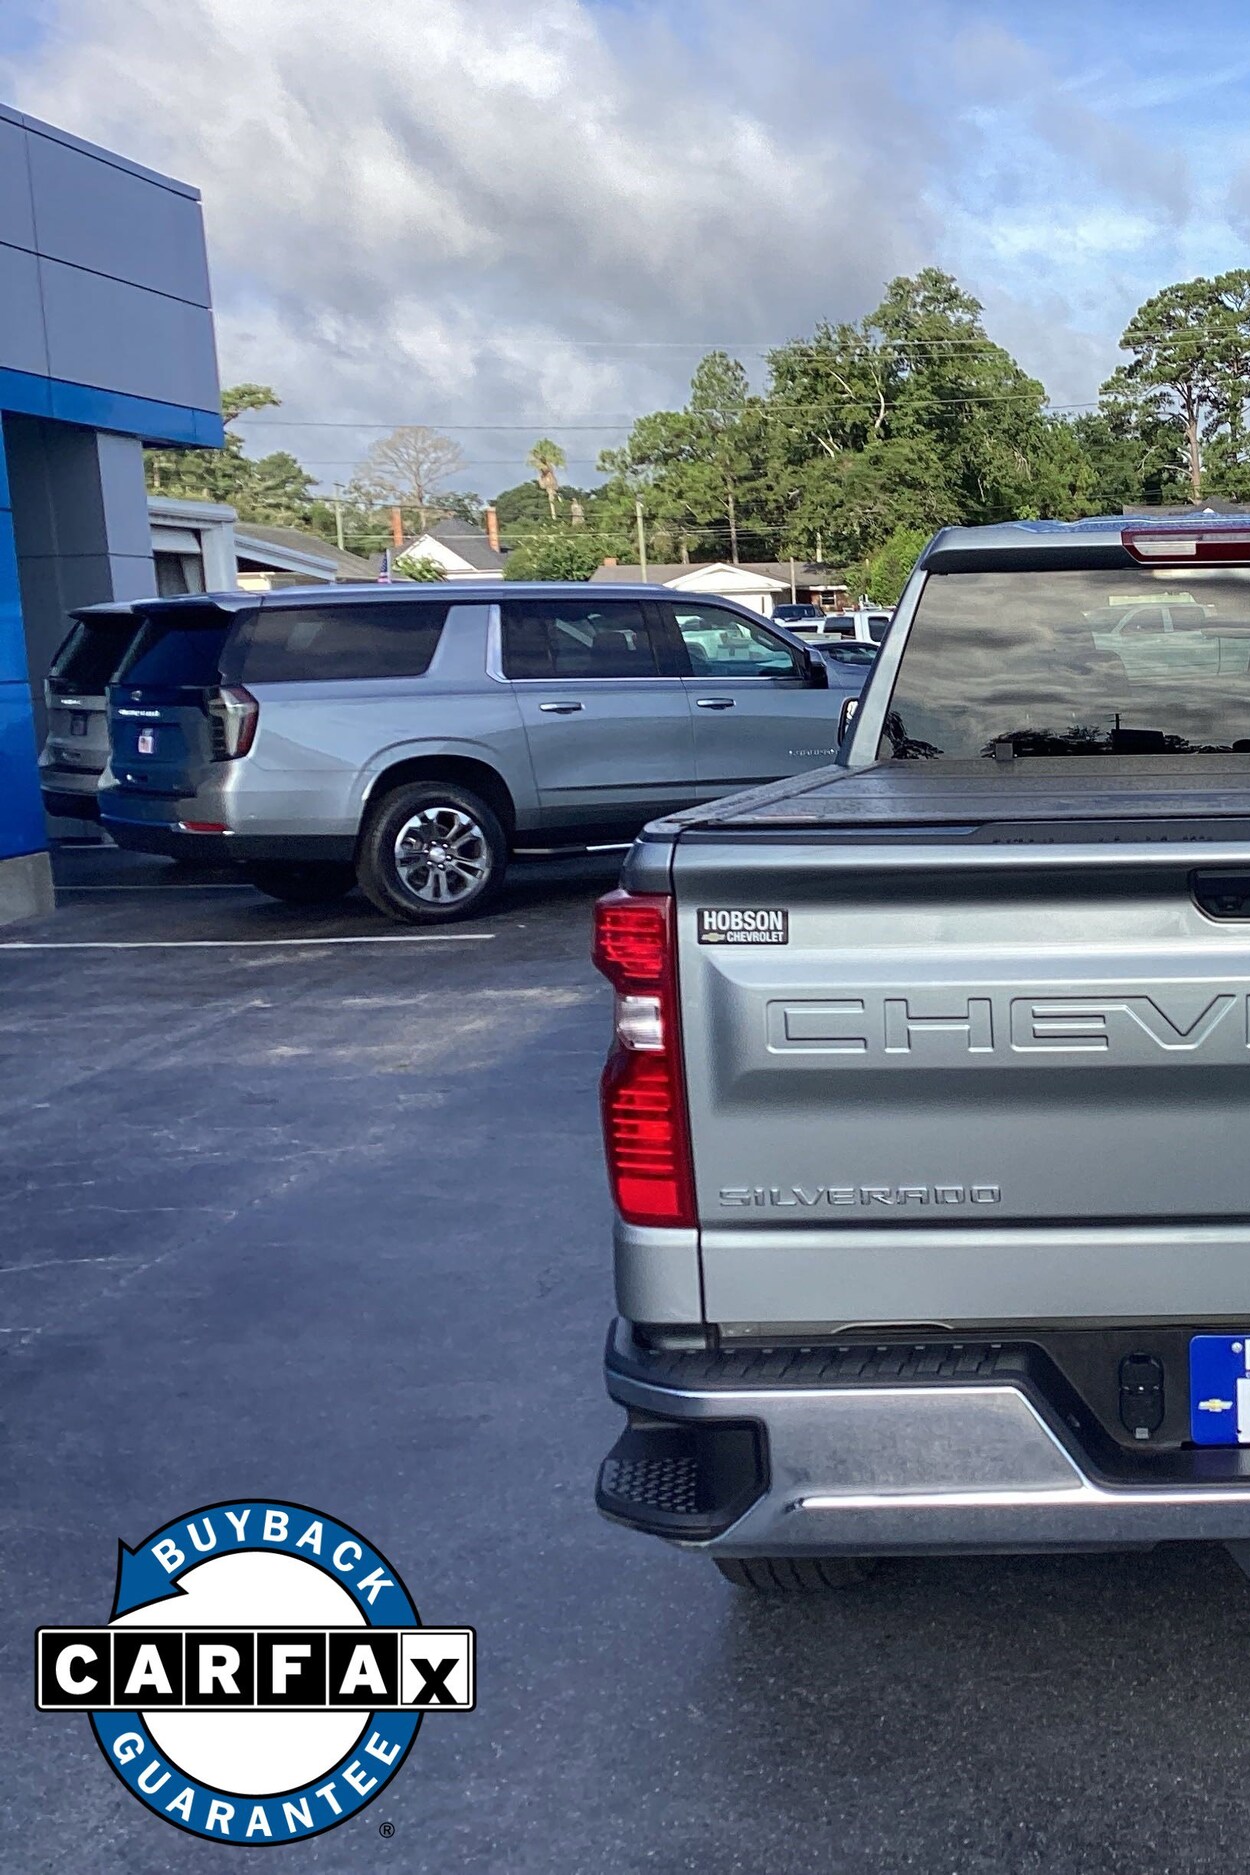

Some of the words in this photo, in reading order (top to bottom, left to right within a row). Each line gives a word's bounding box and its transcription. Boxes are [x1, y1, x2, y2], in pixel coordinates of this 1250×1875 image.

[703, 910, 783, 931] HOBSON
[726, 931, 784, 943] CHEVROLET
[719, 1183, 1002, 1207] SILVERADO
